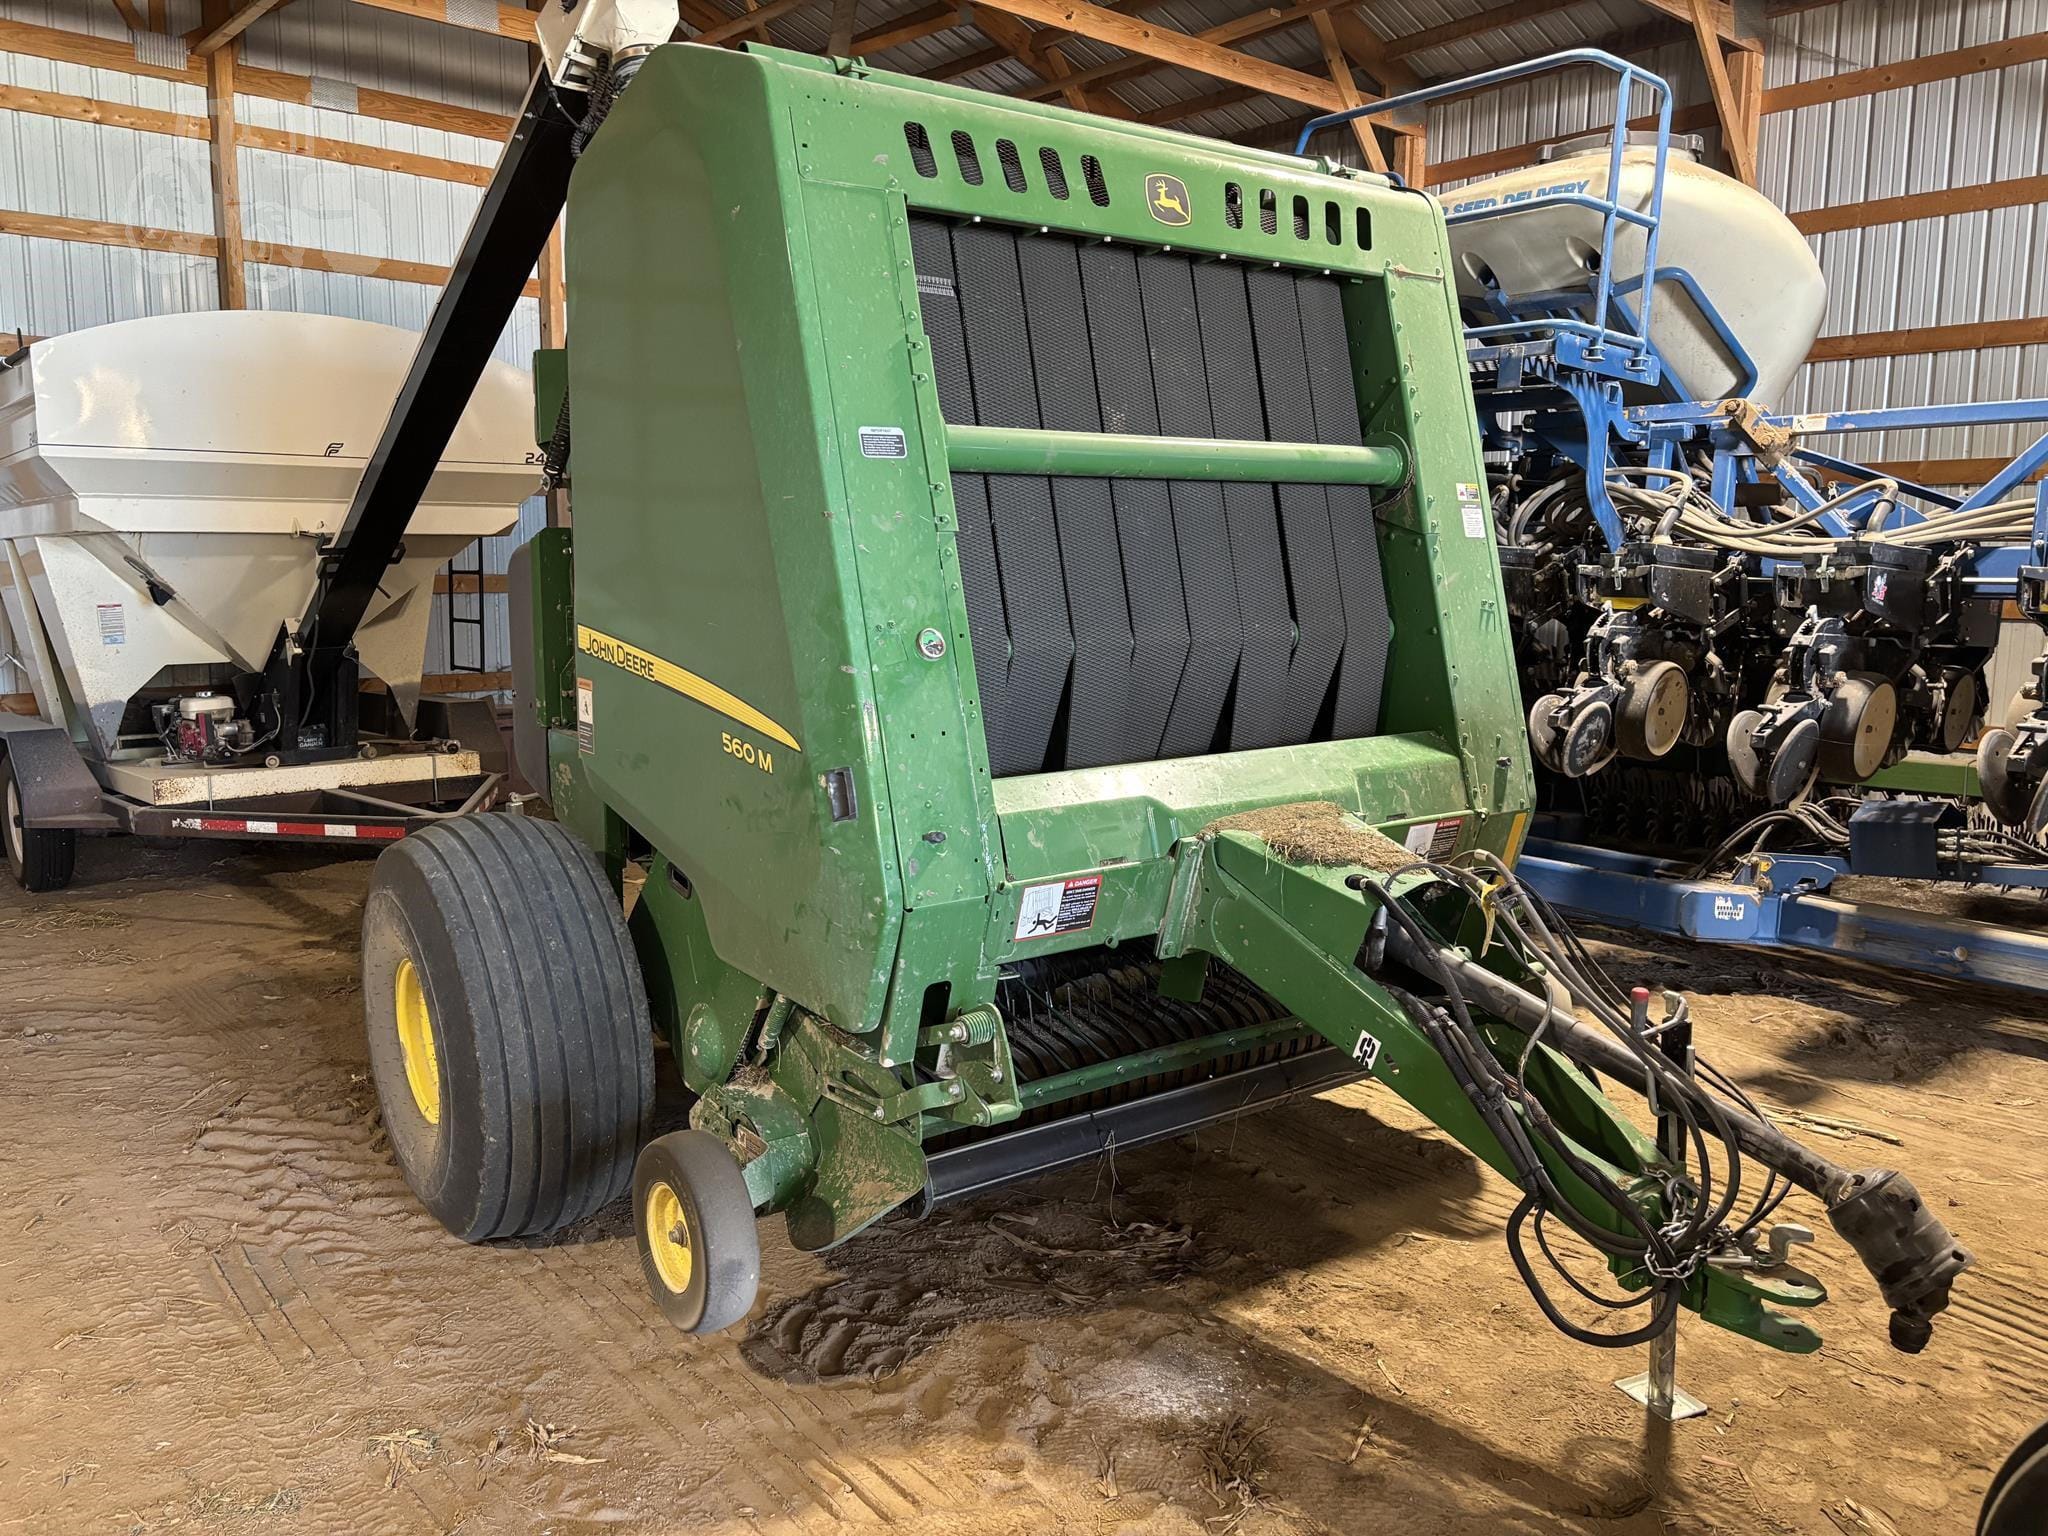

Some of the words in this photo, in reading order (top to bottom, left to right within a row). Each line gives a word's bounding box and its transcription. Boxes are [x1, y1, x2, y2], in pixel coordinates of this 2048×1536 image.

[586, 633, 615, 663] JOHN
[616, 644, 655, 680] DEERE
[721, 731, 756, 765] 560
[757, 748, 773, 775] M
[1074, 878, 1099, 888] DANGER
